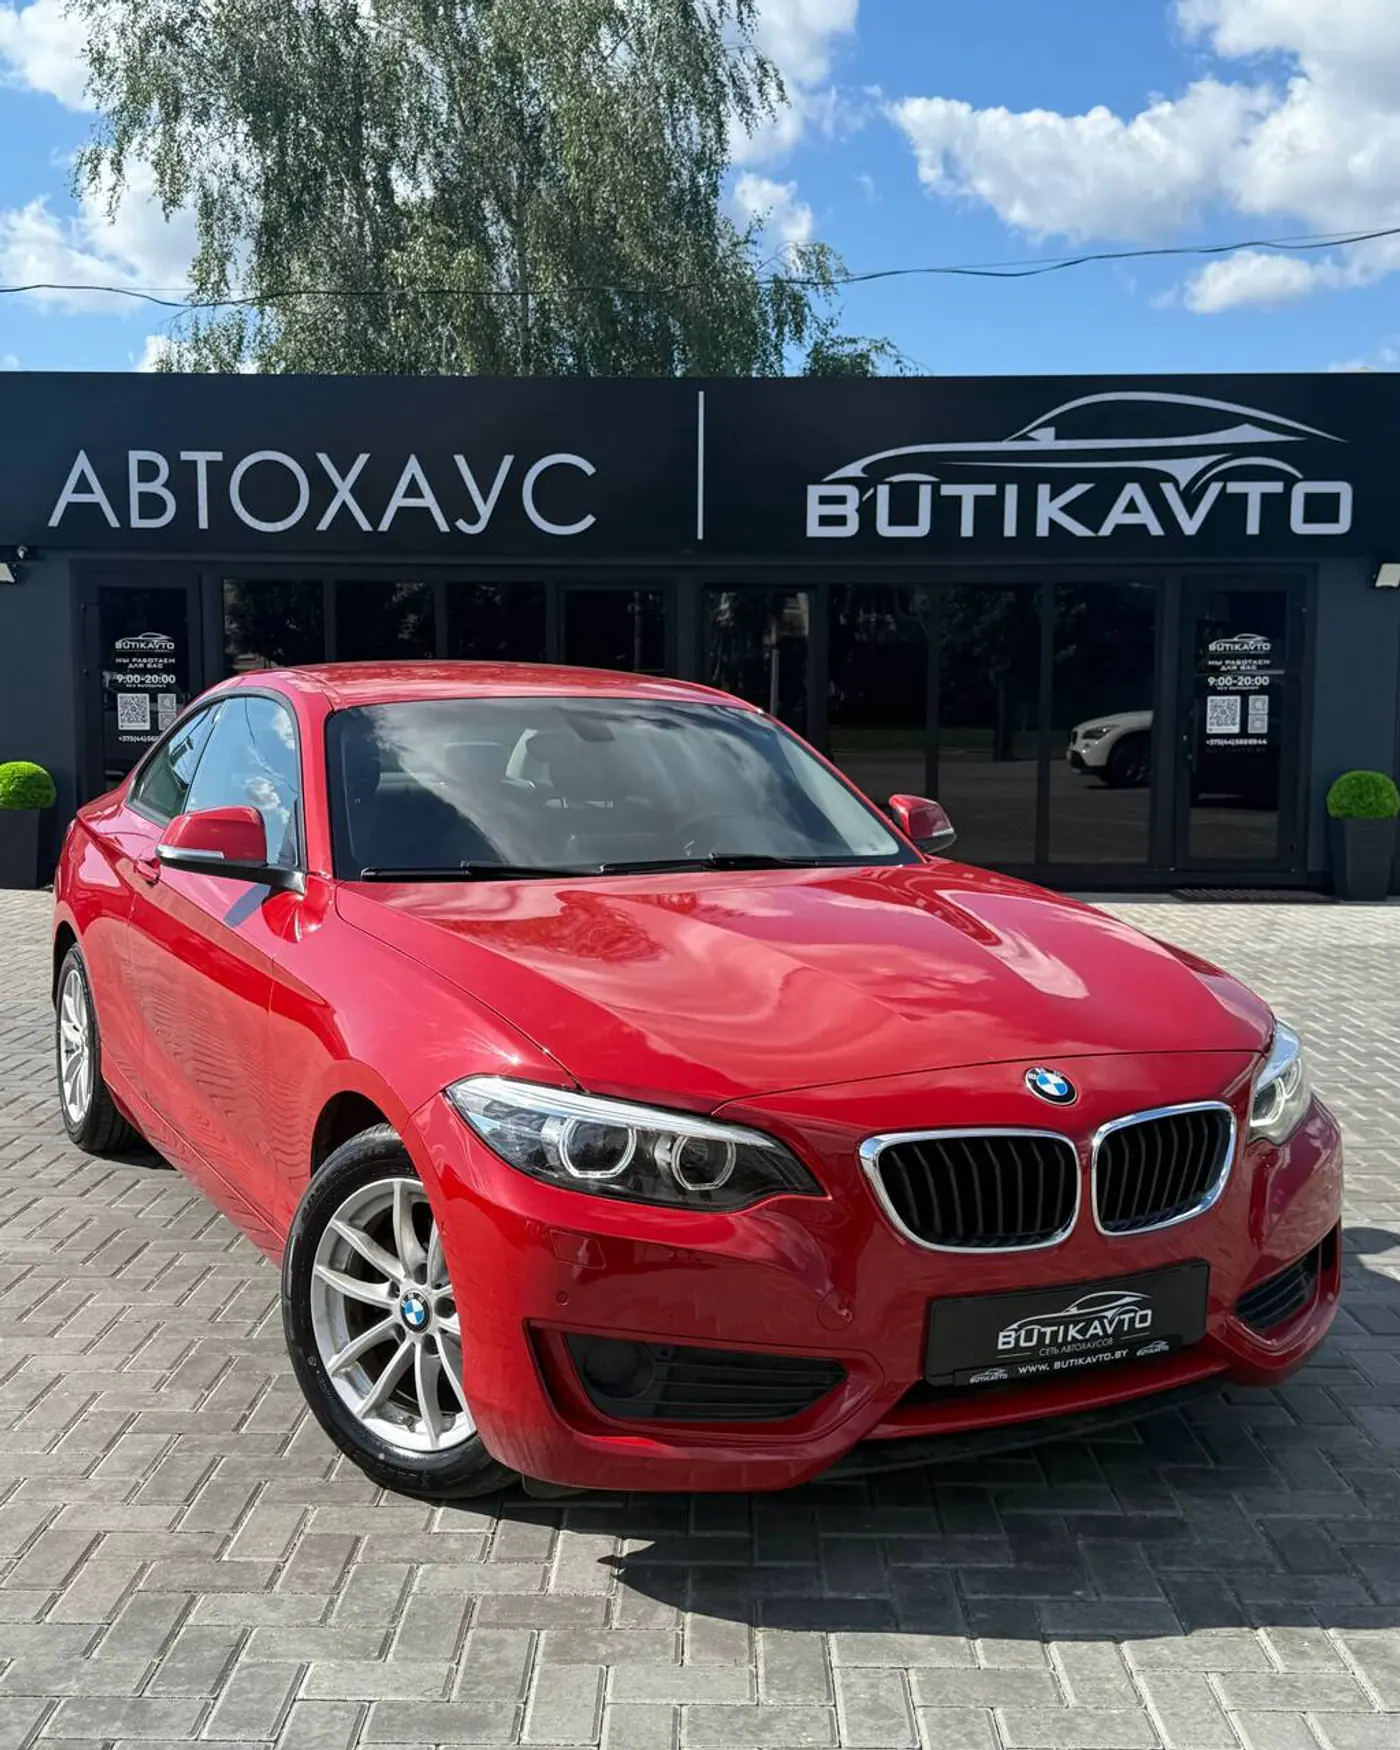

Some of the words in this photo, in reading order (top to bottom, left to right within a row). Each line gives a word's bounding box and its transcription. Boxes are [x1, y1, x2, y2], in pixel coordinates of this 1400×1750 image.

[47, 449, 597, 535] АВТОХАУС
[806, 481, 1353, 537] BUTIKAVTO
[117, 674, 176, 684] 9:00-20:00
[1207, 676, 1269, 686] 9:00-20:00
[997, 1309, 1152, 1349] BUTIKAVTO
